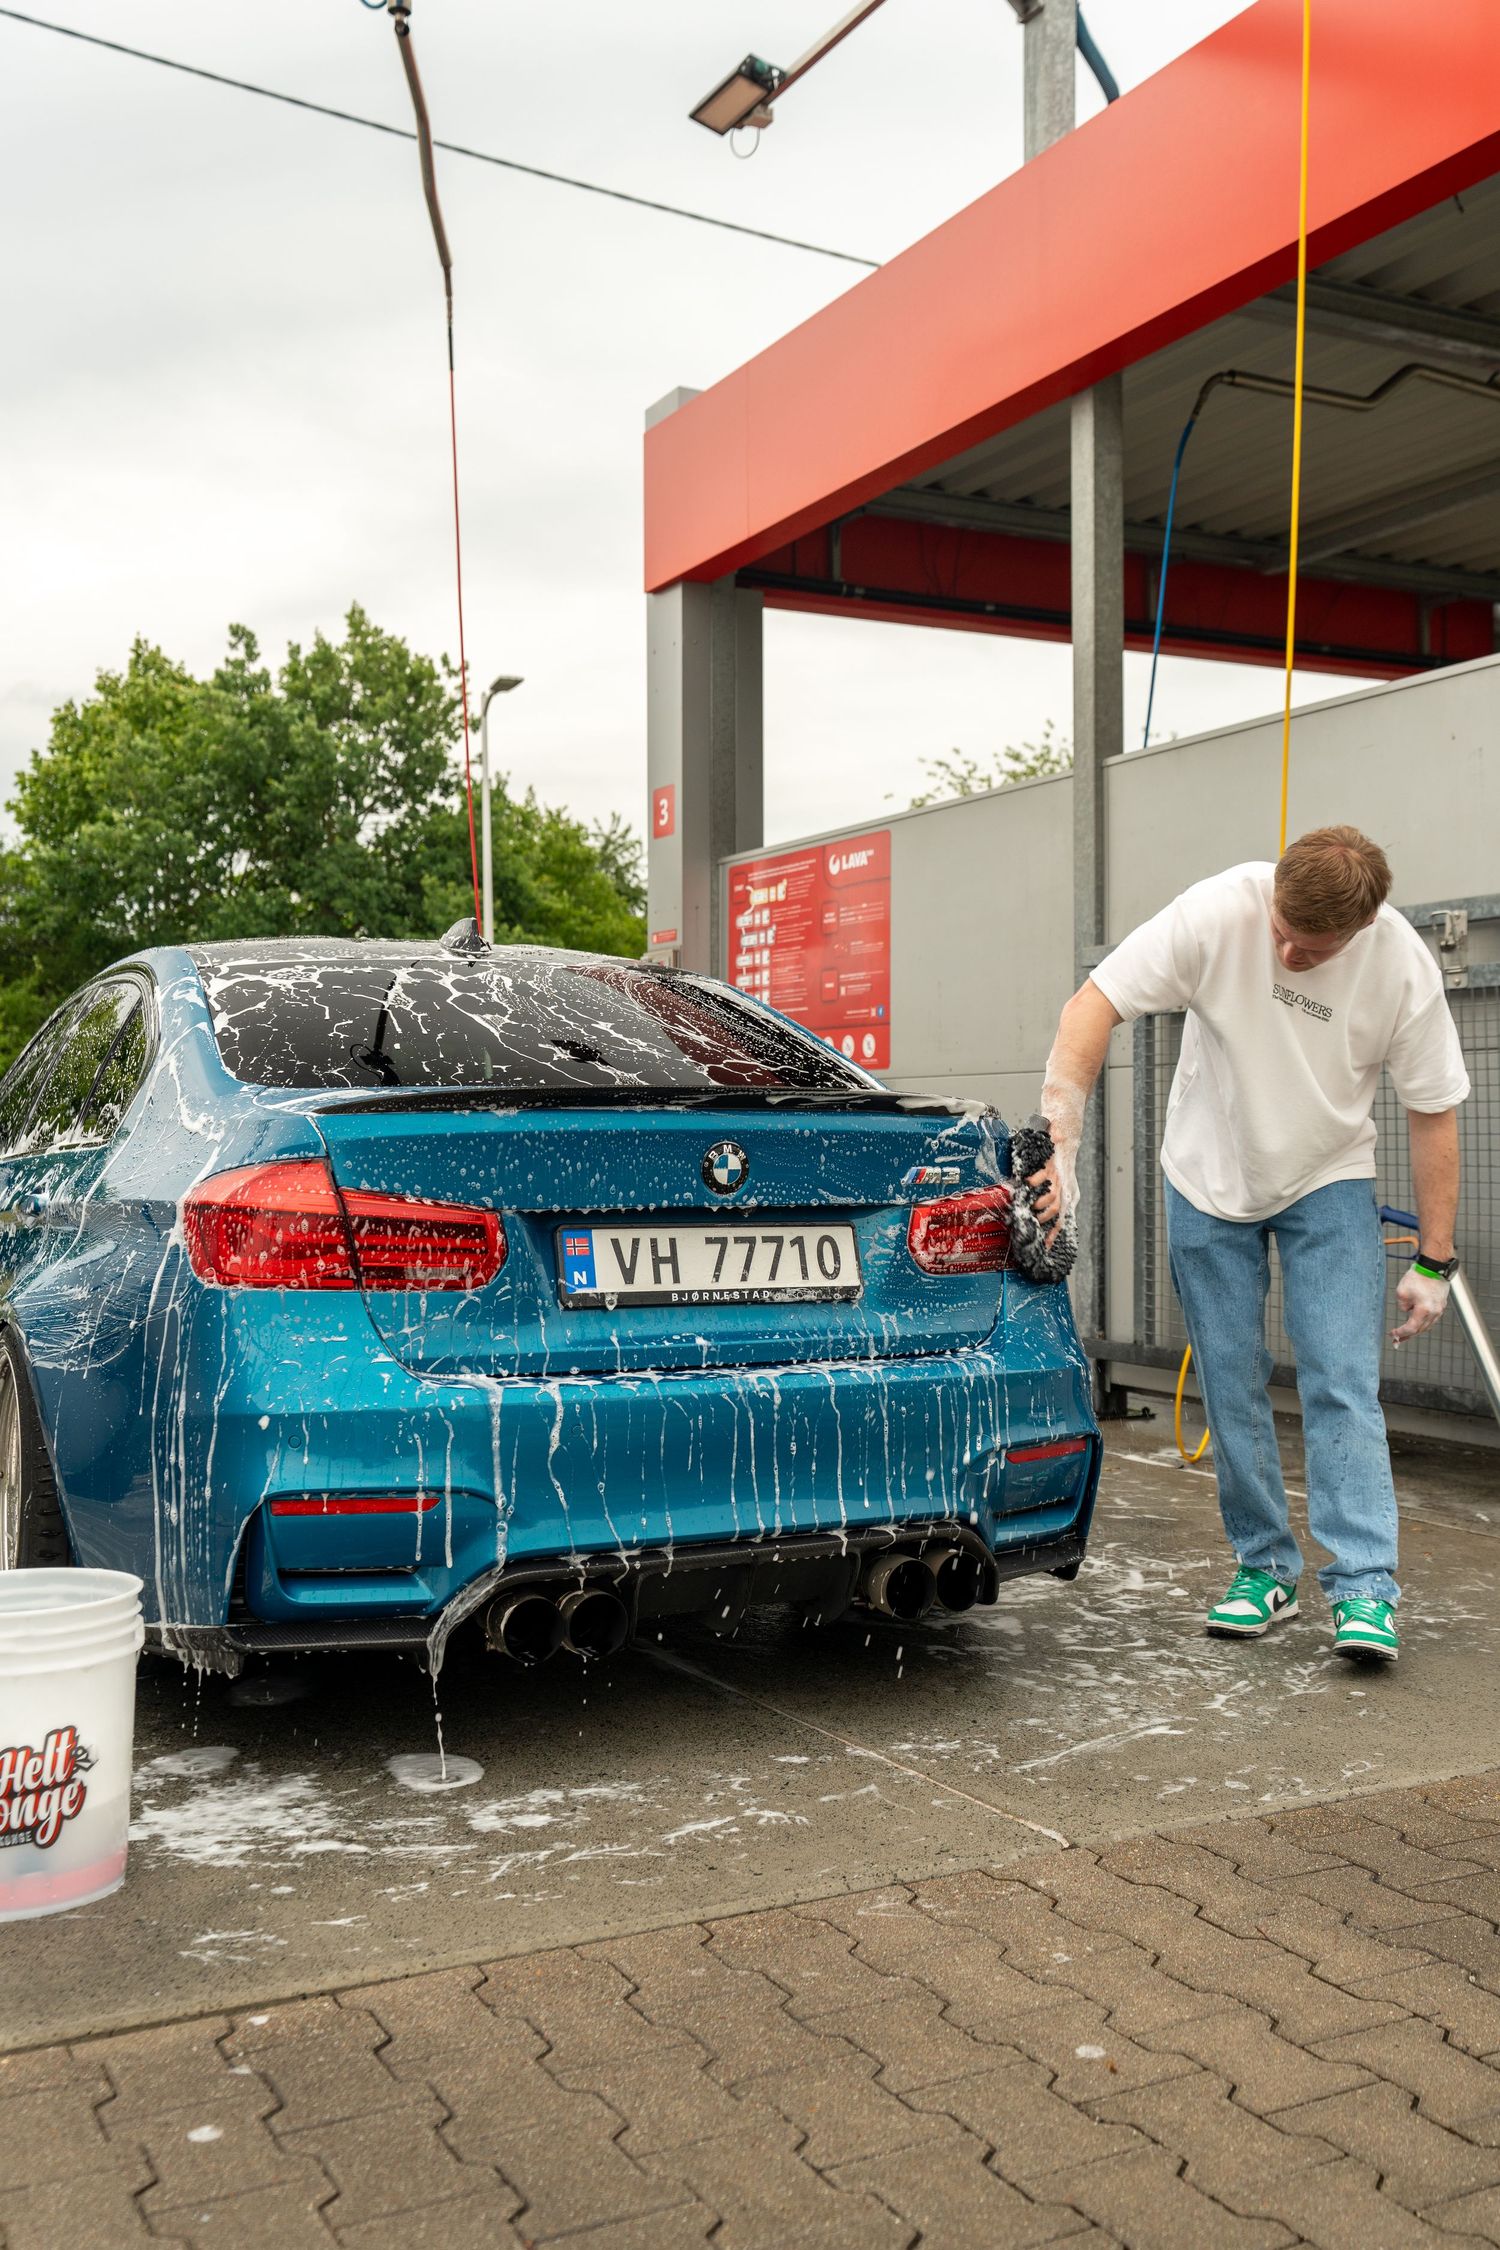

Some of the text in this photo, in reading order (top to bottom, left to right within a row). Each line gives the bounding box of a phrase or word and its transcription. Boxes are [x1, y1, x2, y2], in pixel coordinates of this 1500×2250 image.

[658, 798, 669, 826] 3
[842, 850, 868, 871] LAVA
[1272, 983, 1333, 1018] SUNFLOWERS
[708, 1144, 747, 1161] BMW
[609, 1234, 842, 1285] VH 77710
[573, 1270, 587, 1285] N
[671, 1290, 770, 1302] BJØRNESTAD
[0, 1780, 82, 1846] onge
